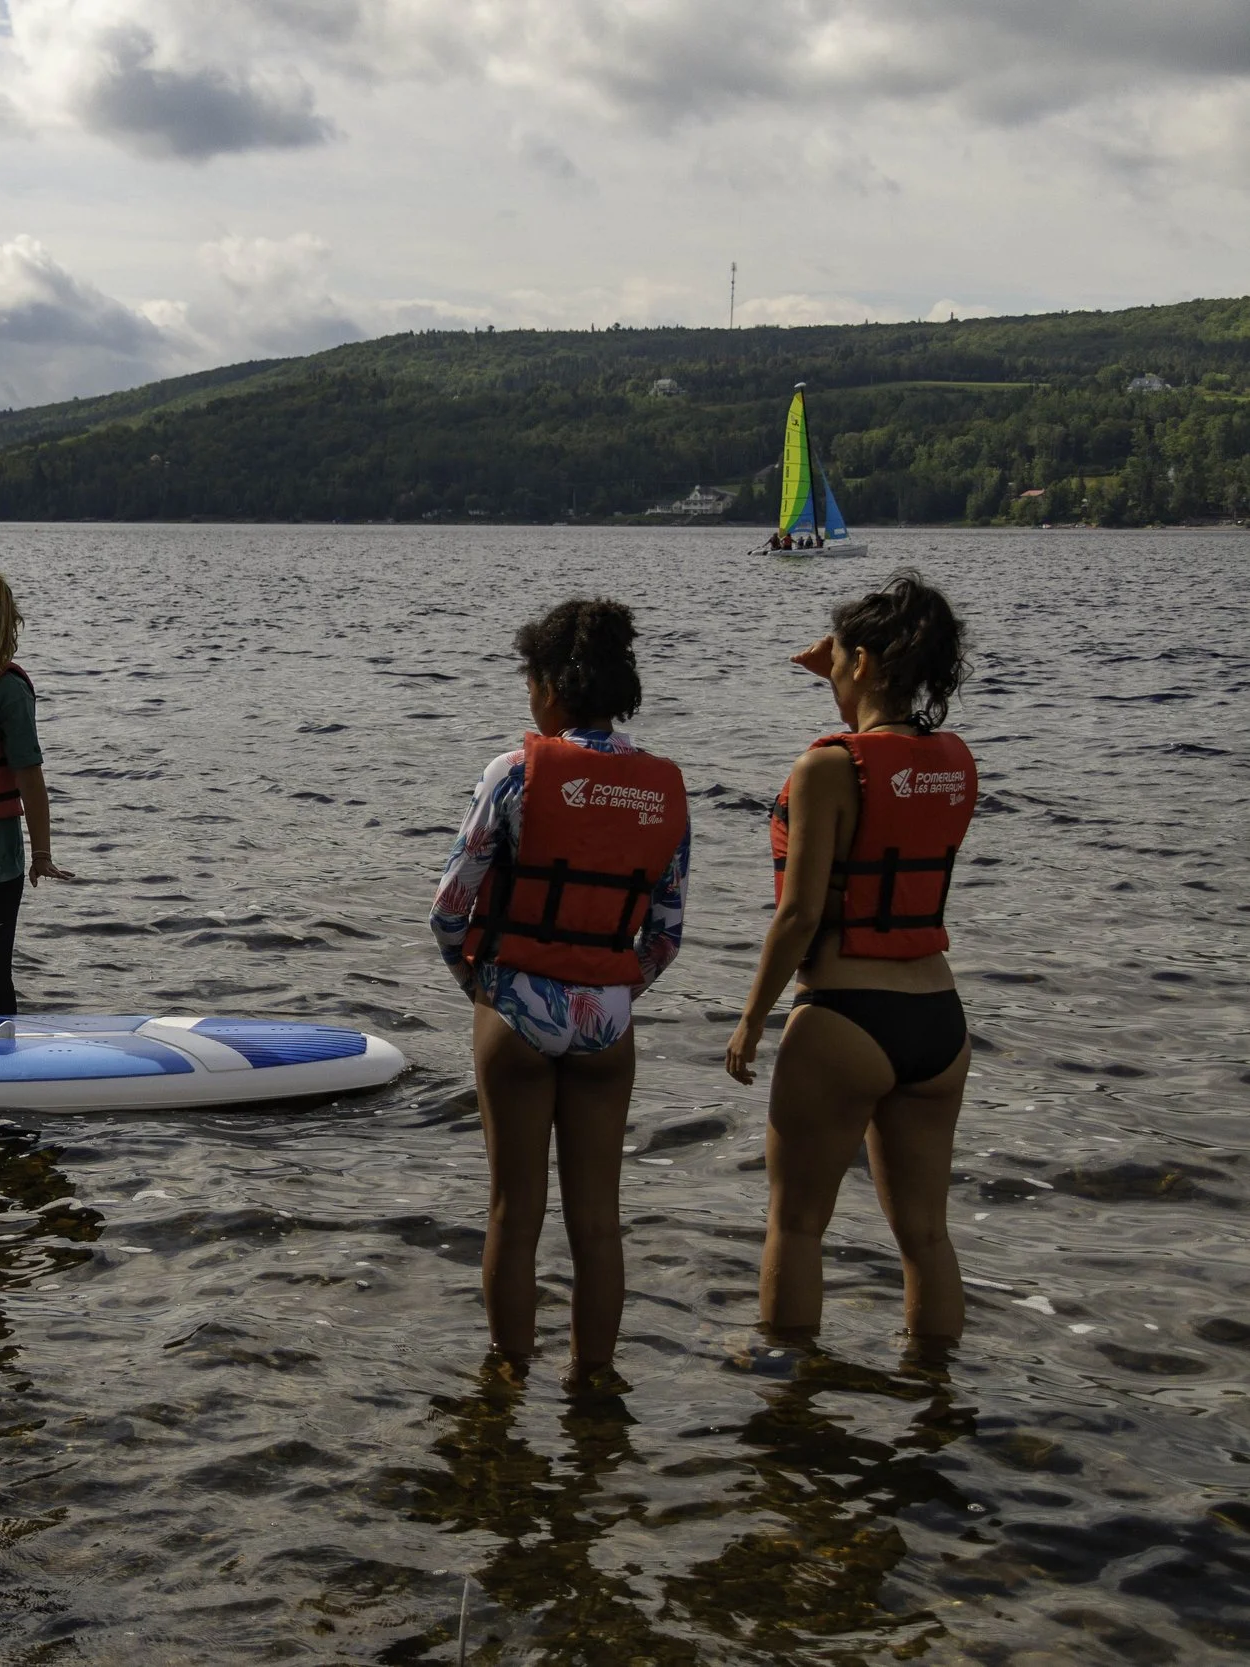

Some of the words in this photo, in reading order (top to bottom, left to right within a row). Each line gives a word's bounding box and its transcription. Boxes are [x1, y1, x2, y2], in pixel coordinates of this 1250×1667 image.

[915, 770, 965, 784] POMERLEAU
[592, 784, 664, 802] POMERLEAU
[914, 784, 928, 793] LES
[590, 795, 606, 805] LES
[610, 798, 660, 812] BATEAUX
[638, 812, 647, 825] 50
